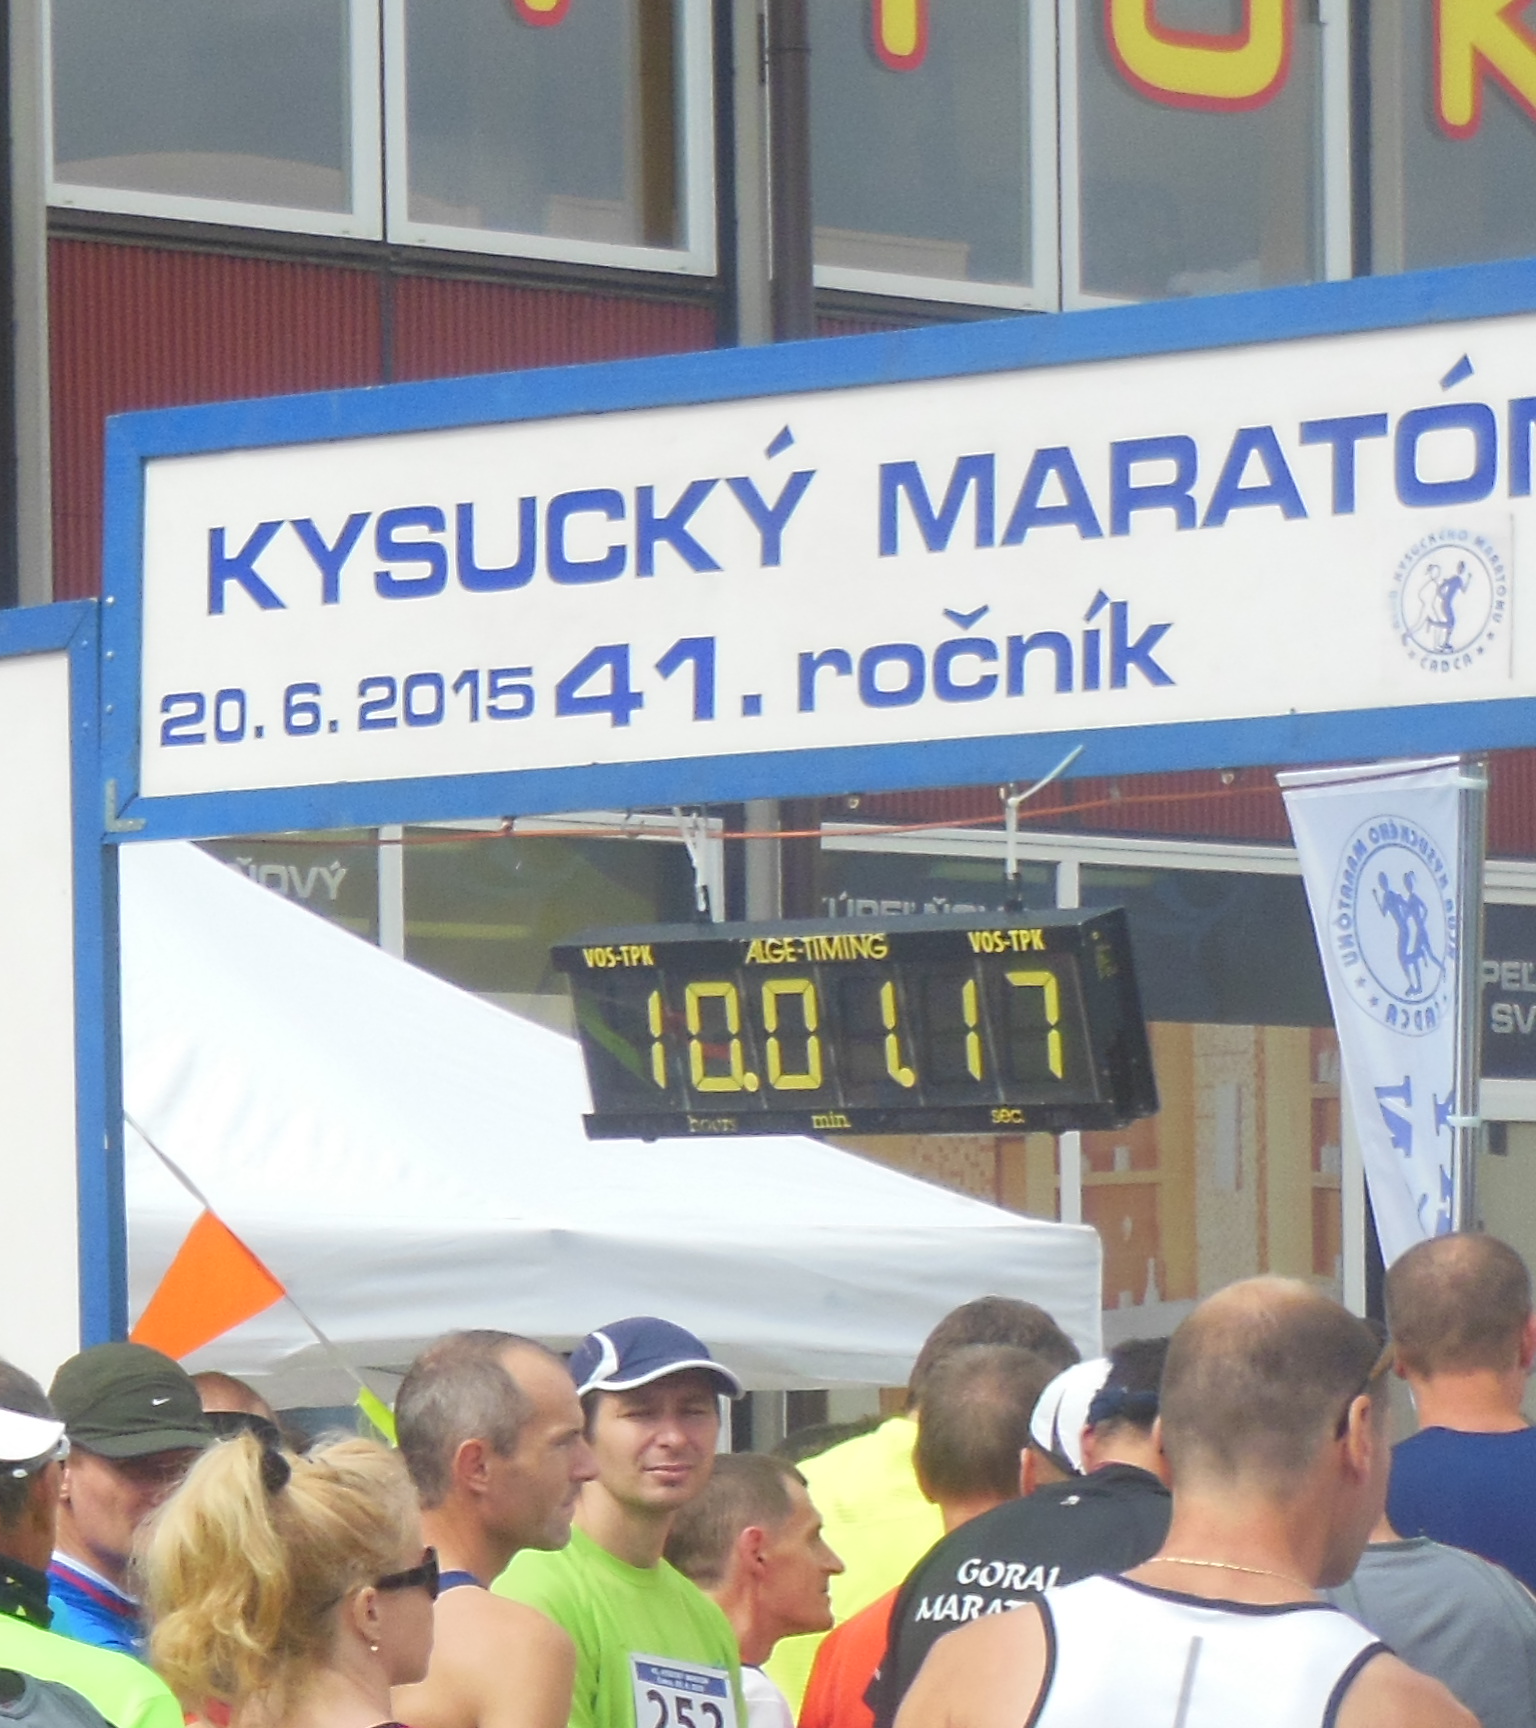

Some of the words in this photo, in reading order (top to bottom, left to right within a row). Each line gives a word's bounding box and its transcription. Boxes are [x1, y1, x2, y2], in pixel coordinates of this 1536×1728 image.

[207, 424, 818, 616] KYSUCKÝ
[160, 687, 265, 747] 20.
[283, 680, 339, 738] 6.
[358, 665, 536, 732] 2015
[554, 635, 764, 728] 41.
[797, 588, 1178, 714] ročník
[583, 946, 655, 969] VOS-TPK
[744, 932, 889, 965] ALGE-TIMING
[967, 929, 1046, 955] VOS-TPK
[956, 1557, 1064, 1593] GORAL
